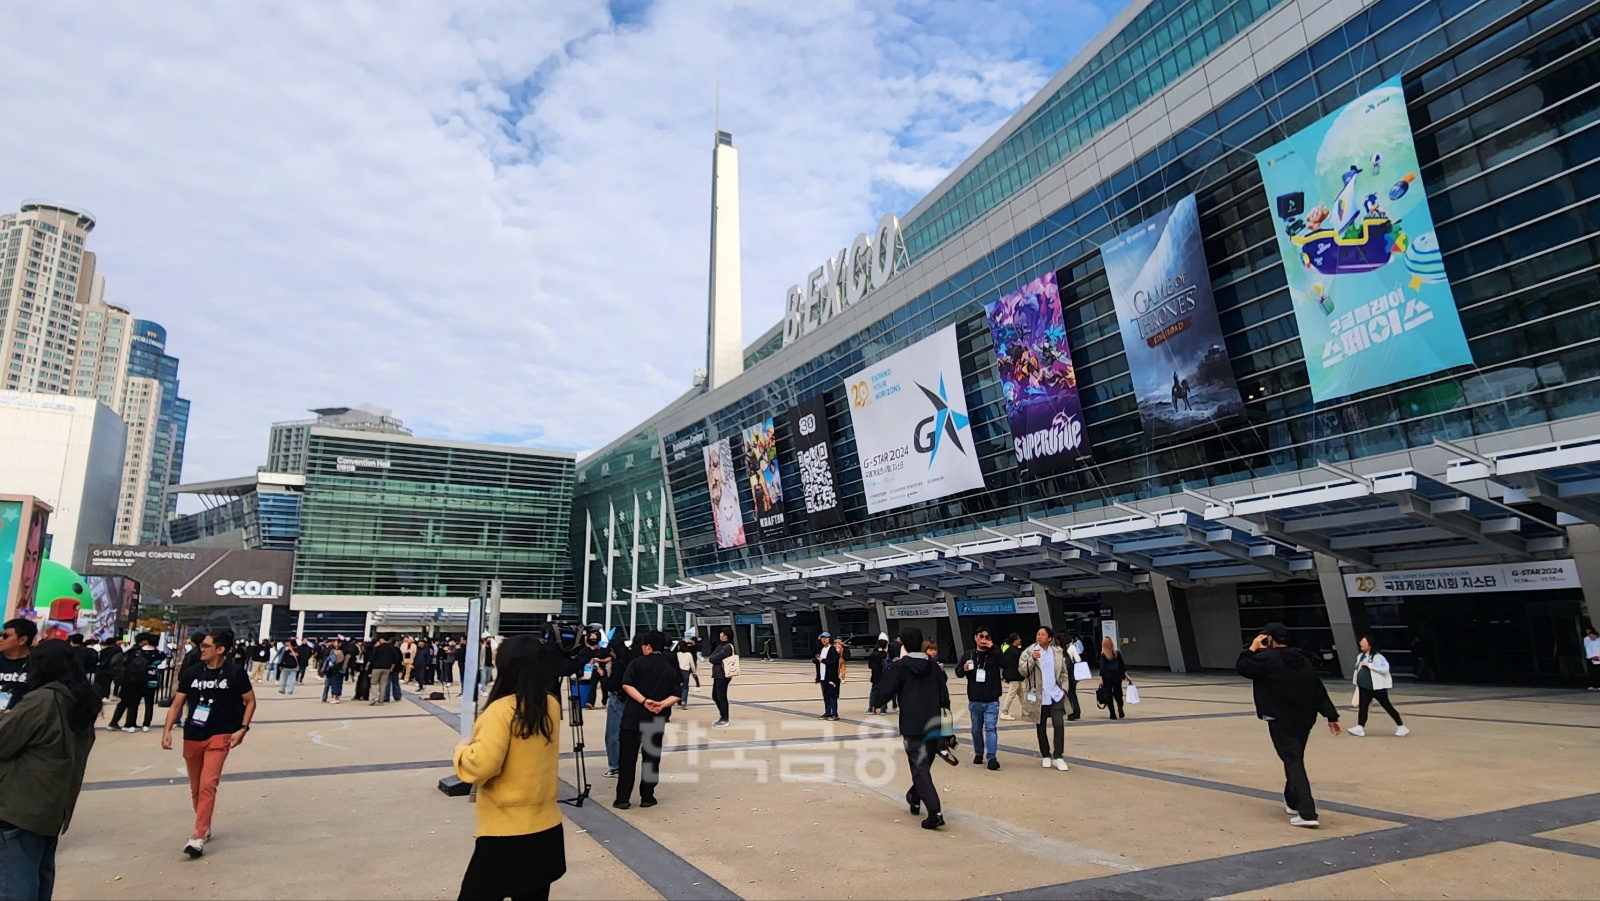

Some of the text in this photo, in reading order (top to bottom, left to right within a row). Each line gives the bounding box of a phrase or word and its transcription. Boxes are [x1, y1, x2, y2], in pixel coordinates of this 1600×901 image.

[782, 213, 897, 348] BEXCO
[1133, 277, 1175, 314] GAME
[1130, 290, 1197, 338] THRONES
[1329, 287, 1405, 336] 구글플레이
[1322, 298, 1434, 369] 스페이스
[871, 368, 892, 383] EXPAND
[873, 380, 887, 391] YOUR
[875, 384, 901, 400] HORIZONS
[799, 413, 816, 436] 30
[336, 456, 391, 468] Convention Hall
[889, 445, 909, 461] 2024
[1384, 578, 1459, 592] 국제게임전시회
[1461, 575, 1497, 589] 지스타
